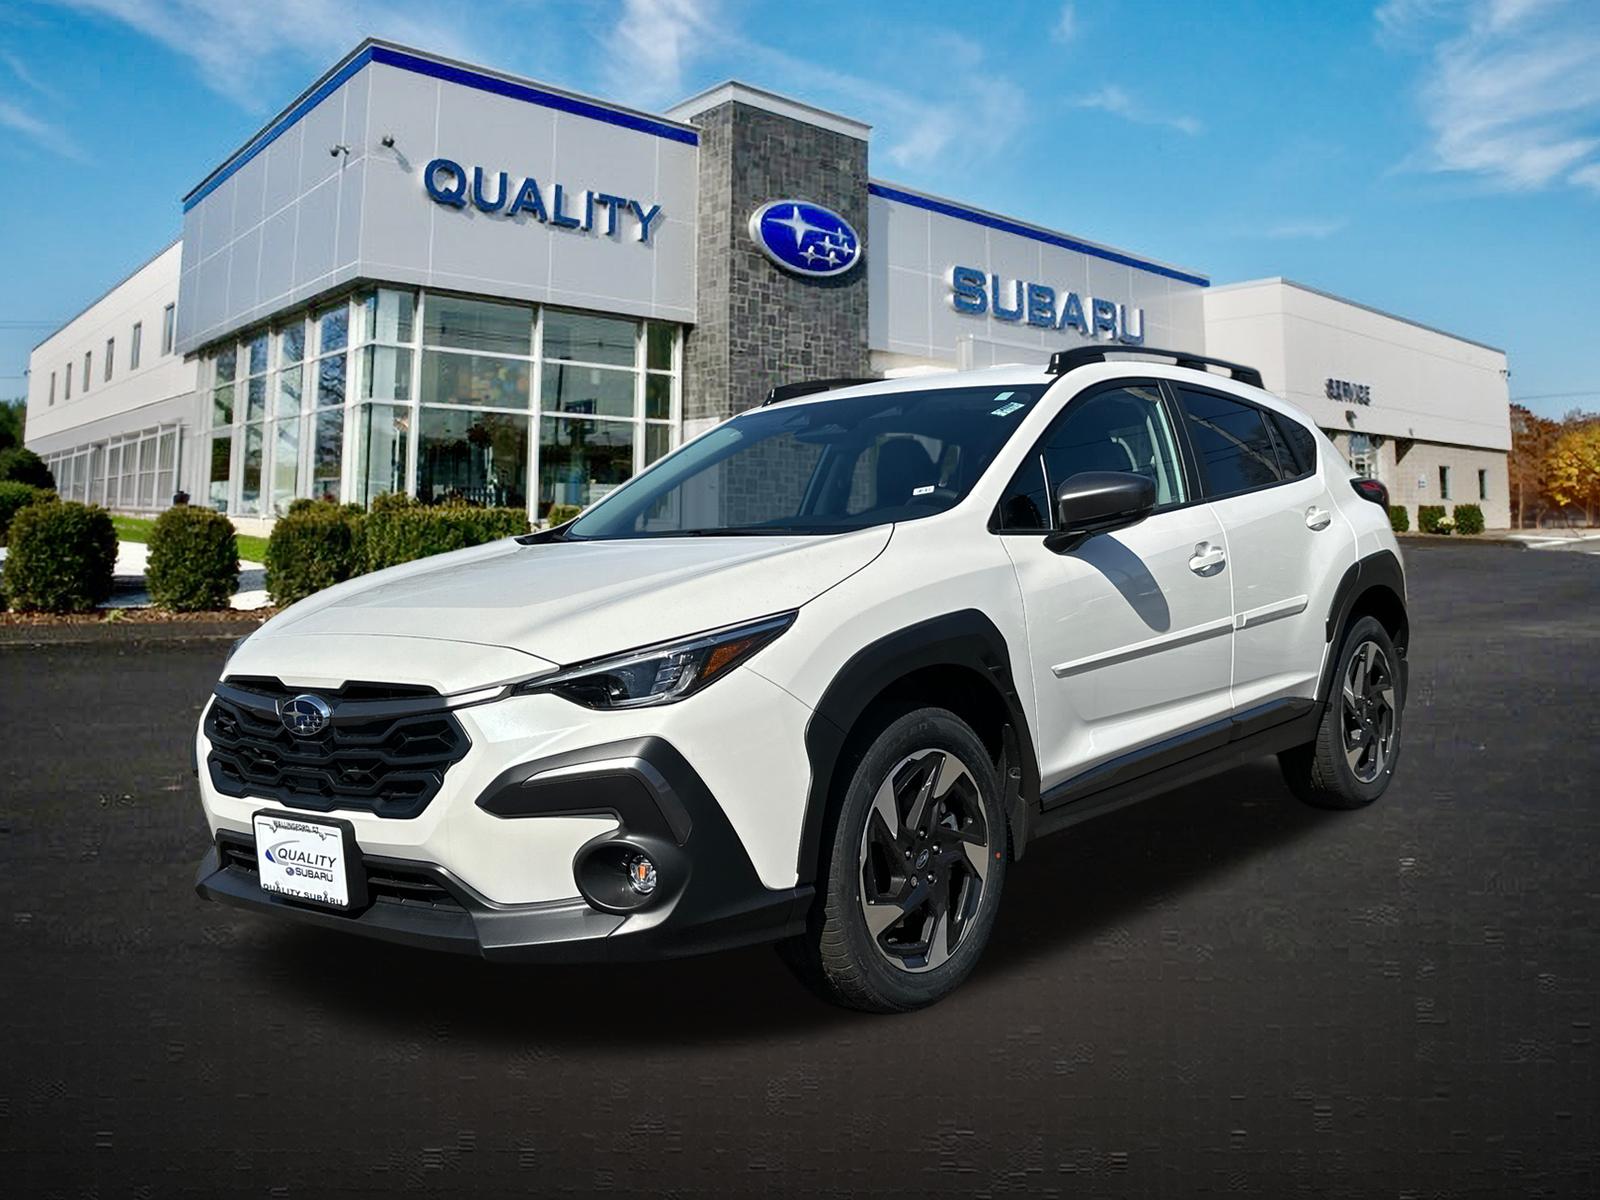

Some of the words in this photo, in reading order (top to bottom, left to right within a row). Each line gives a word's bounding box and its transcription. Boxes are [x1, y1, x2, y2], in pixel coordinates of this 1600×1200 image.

[424, 158, 661, 243] QUALITY
[951, 265, 1145, 345] SUBARU
[1325, 378, 1370, 406] SERVICE
[278, 848, 337, 868] QUALITY
[295, 867, 333, 882] SUBARU
